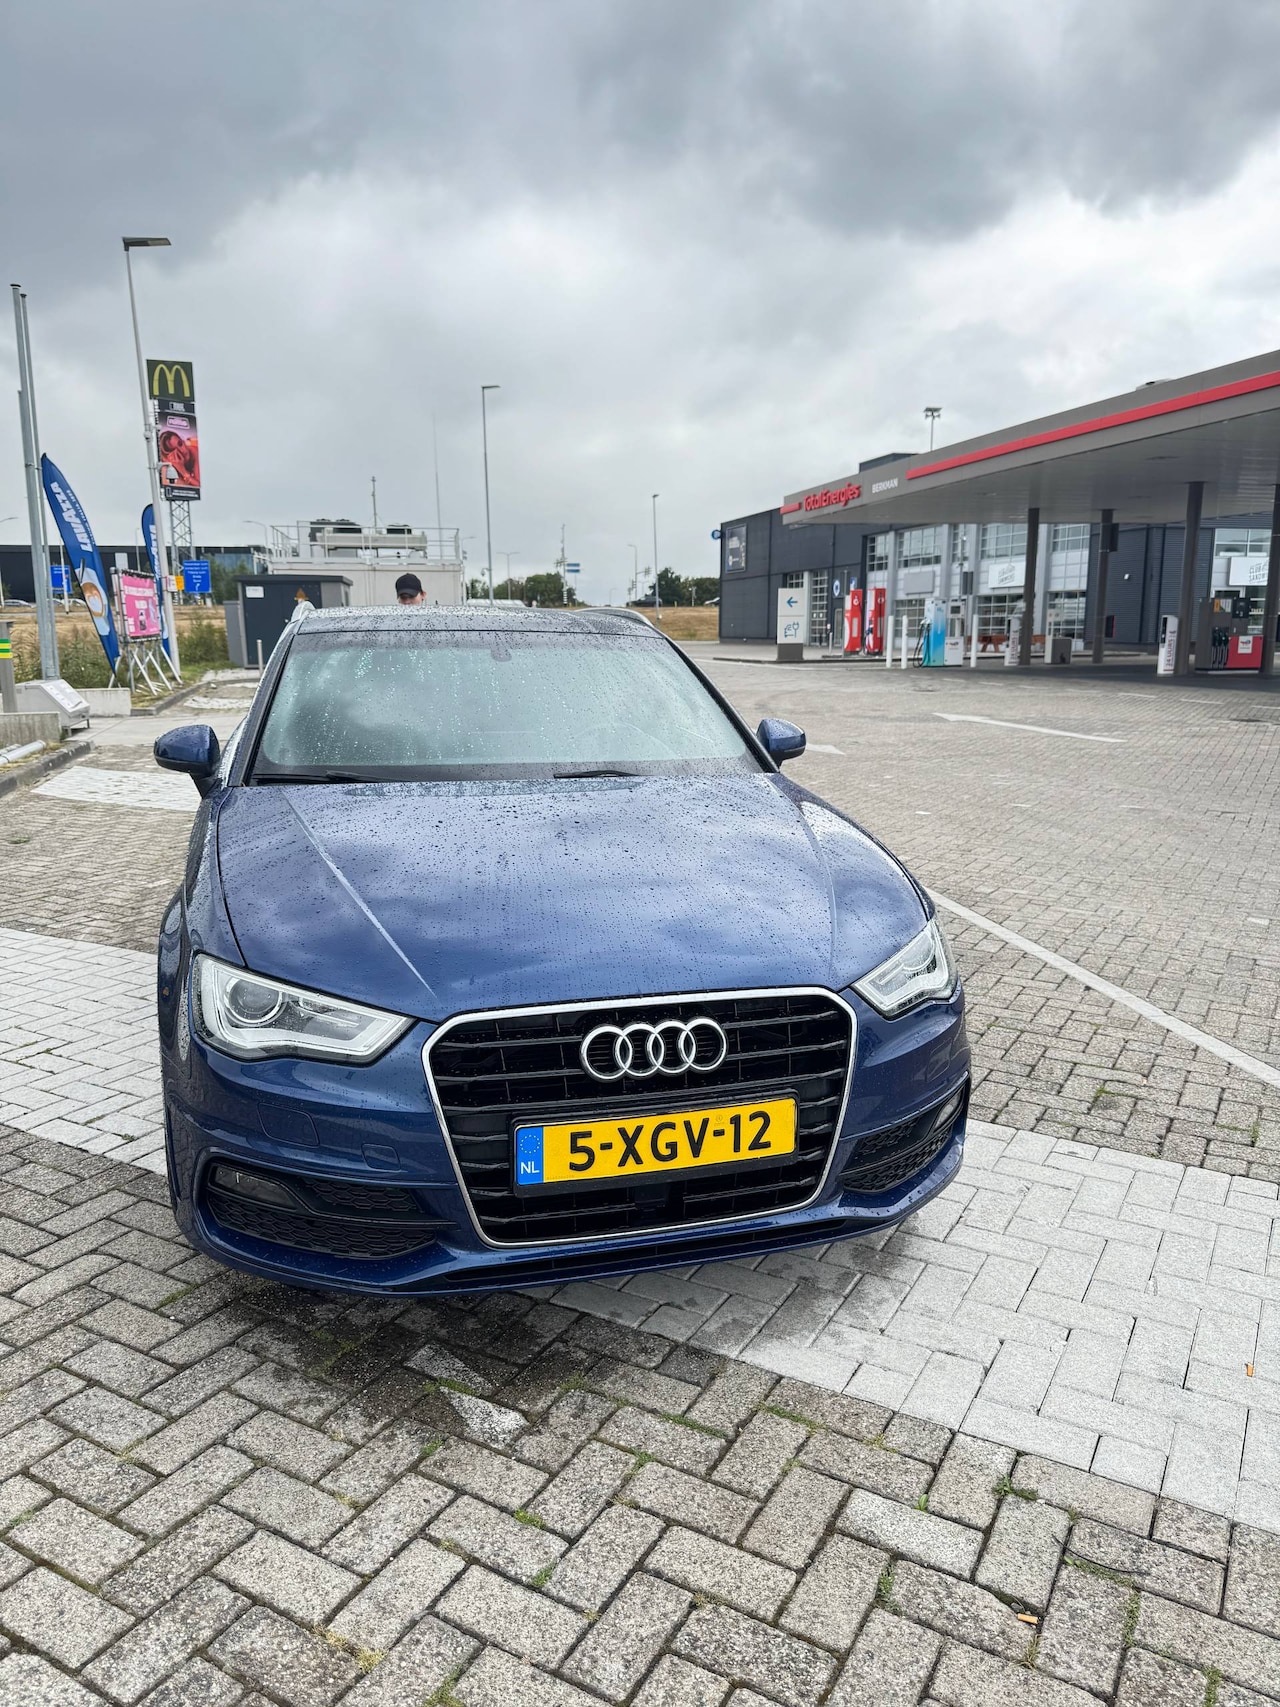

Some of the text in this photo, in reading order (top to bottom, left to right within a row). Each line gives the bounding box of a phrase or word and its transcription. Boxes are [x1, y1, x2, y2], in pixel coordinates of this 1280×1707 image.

[803, 482, 861, 511] TotalEnergies
[872, 478, 898, 493] BERKMAN
[50, 481, 93, 552] LAVAZZA
[569, 1111, 771, 1171] 5-XGV-12
[521, 1161, 540, 1174] NL
